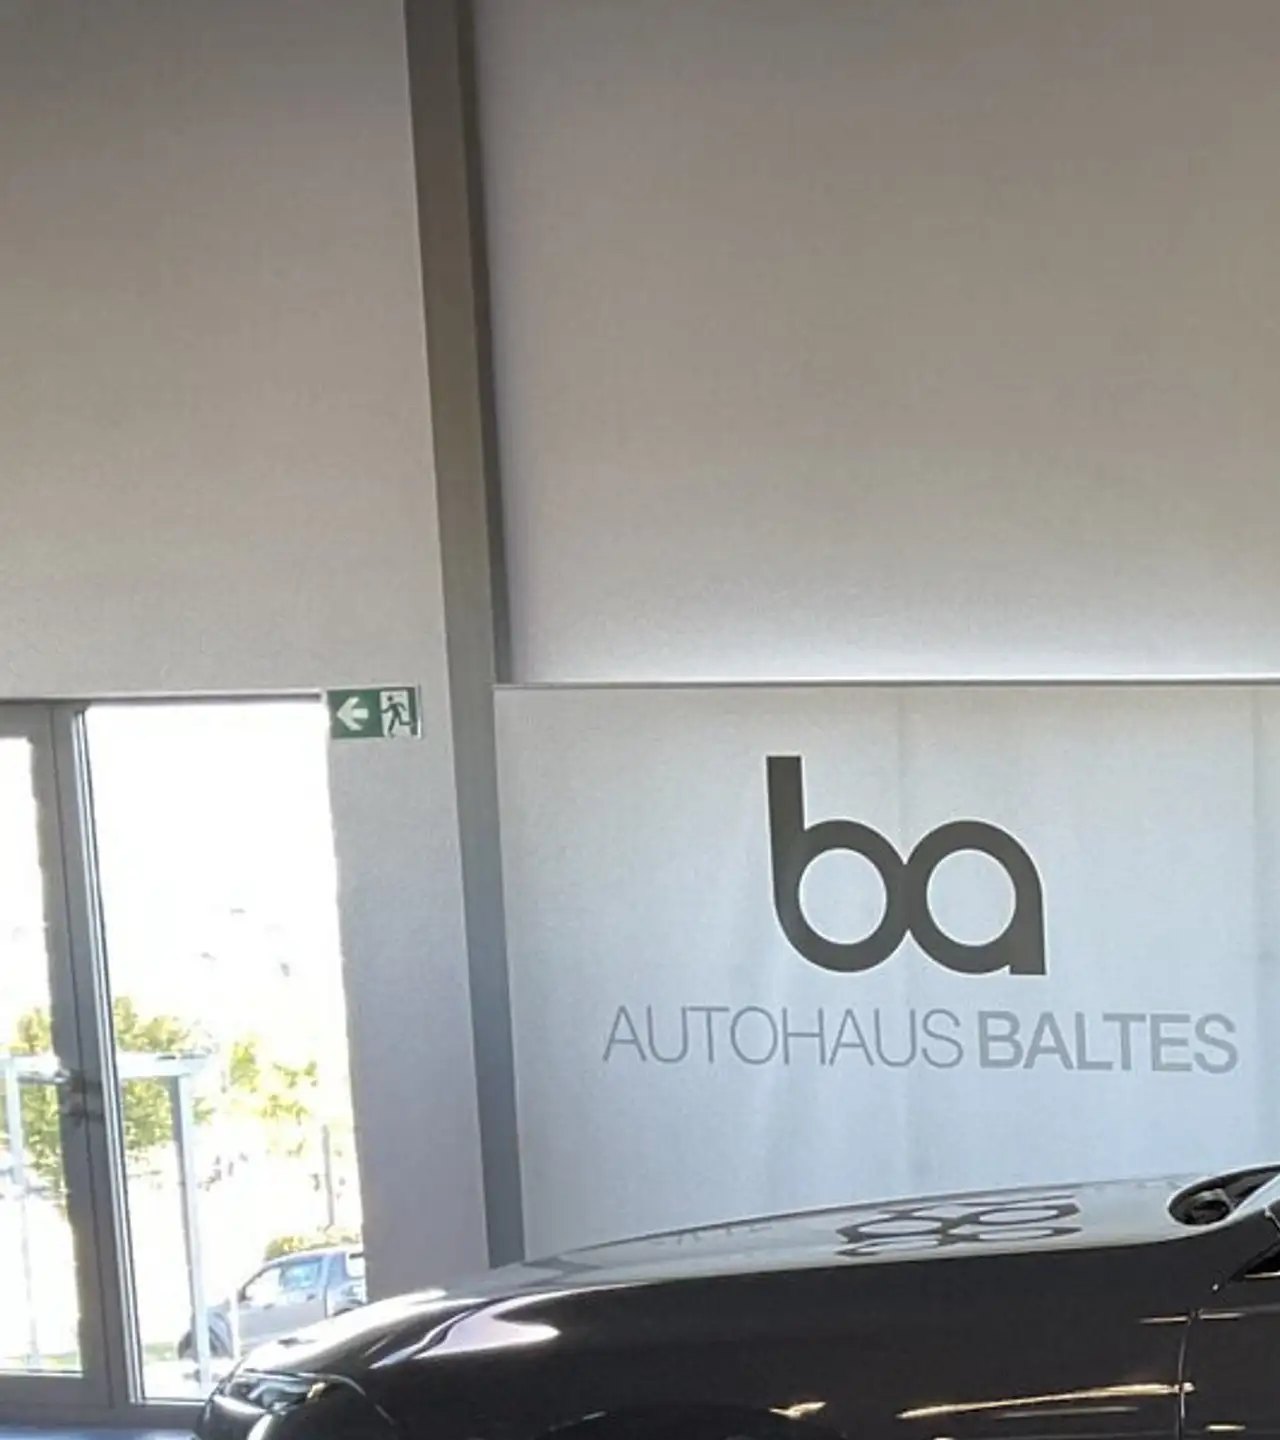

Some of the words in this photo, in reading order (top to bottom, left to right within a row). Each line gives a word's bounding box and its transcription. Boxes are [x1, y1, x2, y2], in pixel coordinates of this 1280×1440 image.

[767, 755, 1046, 974] ba
[603, 1004, 963, 1068] AUTOHAUS
[977, 1010, 1238, 1073] BALTES
